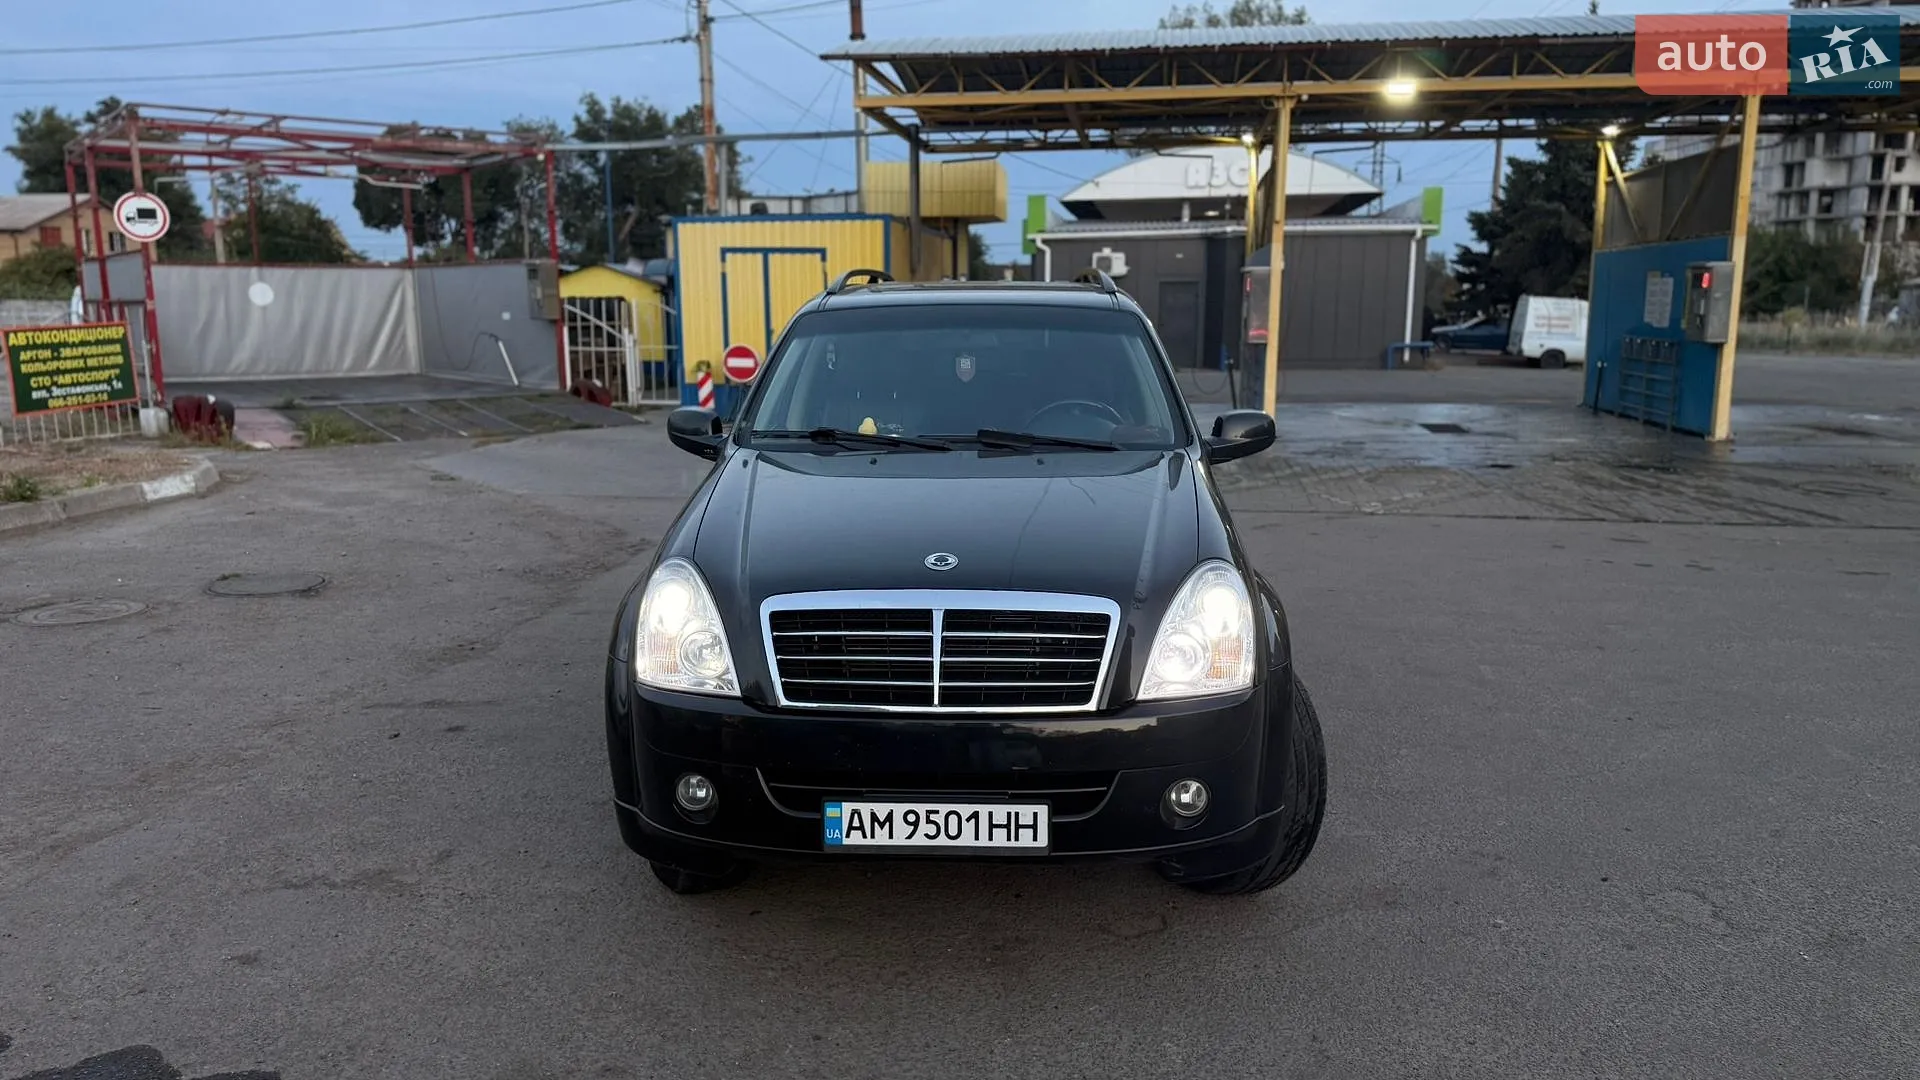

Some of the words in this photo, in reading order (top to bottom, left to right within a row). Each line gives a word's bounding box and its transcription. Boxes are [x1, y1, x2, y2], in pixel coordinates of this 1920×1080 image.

[8, 326, 125, 347] АВТОКОНДИЦІОНЕР
[19, 348, 51, 362] АРГОН
[30, 375, 51, 388] СТО
[826, 829, 841, 839] UA
